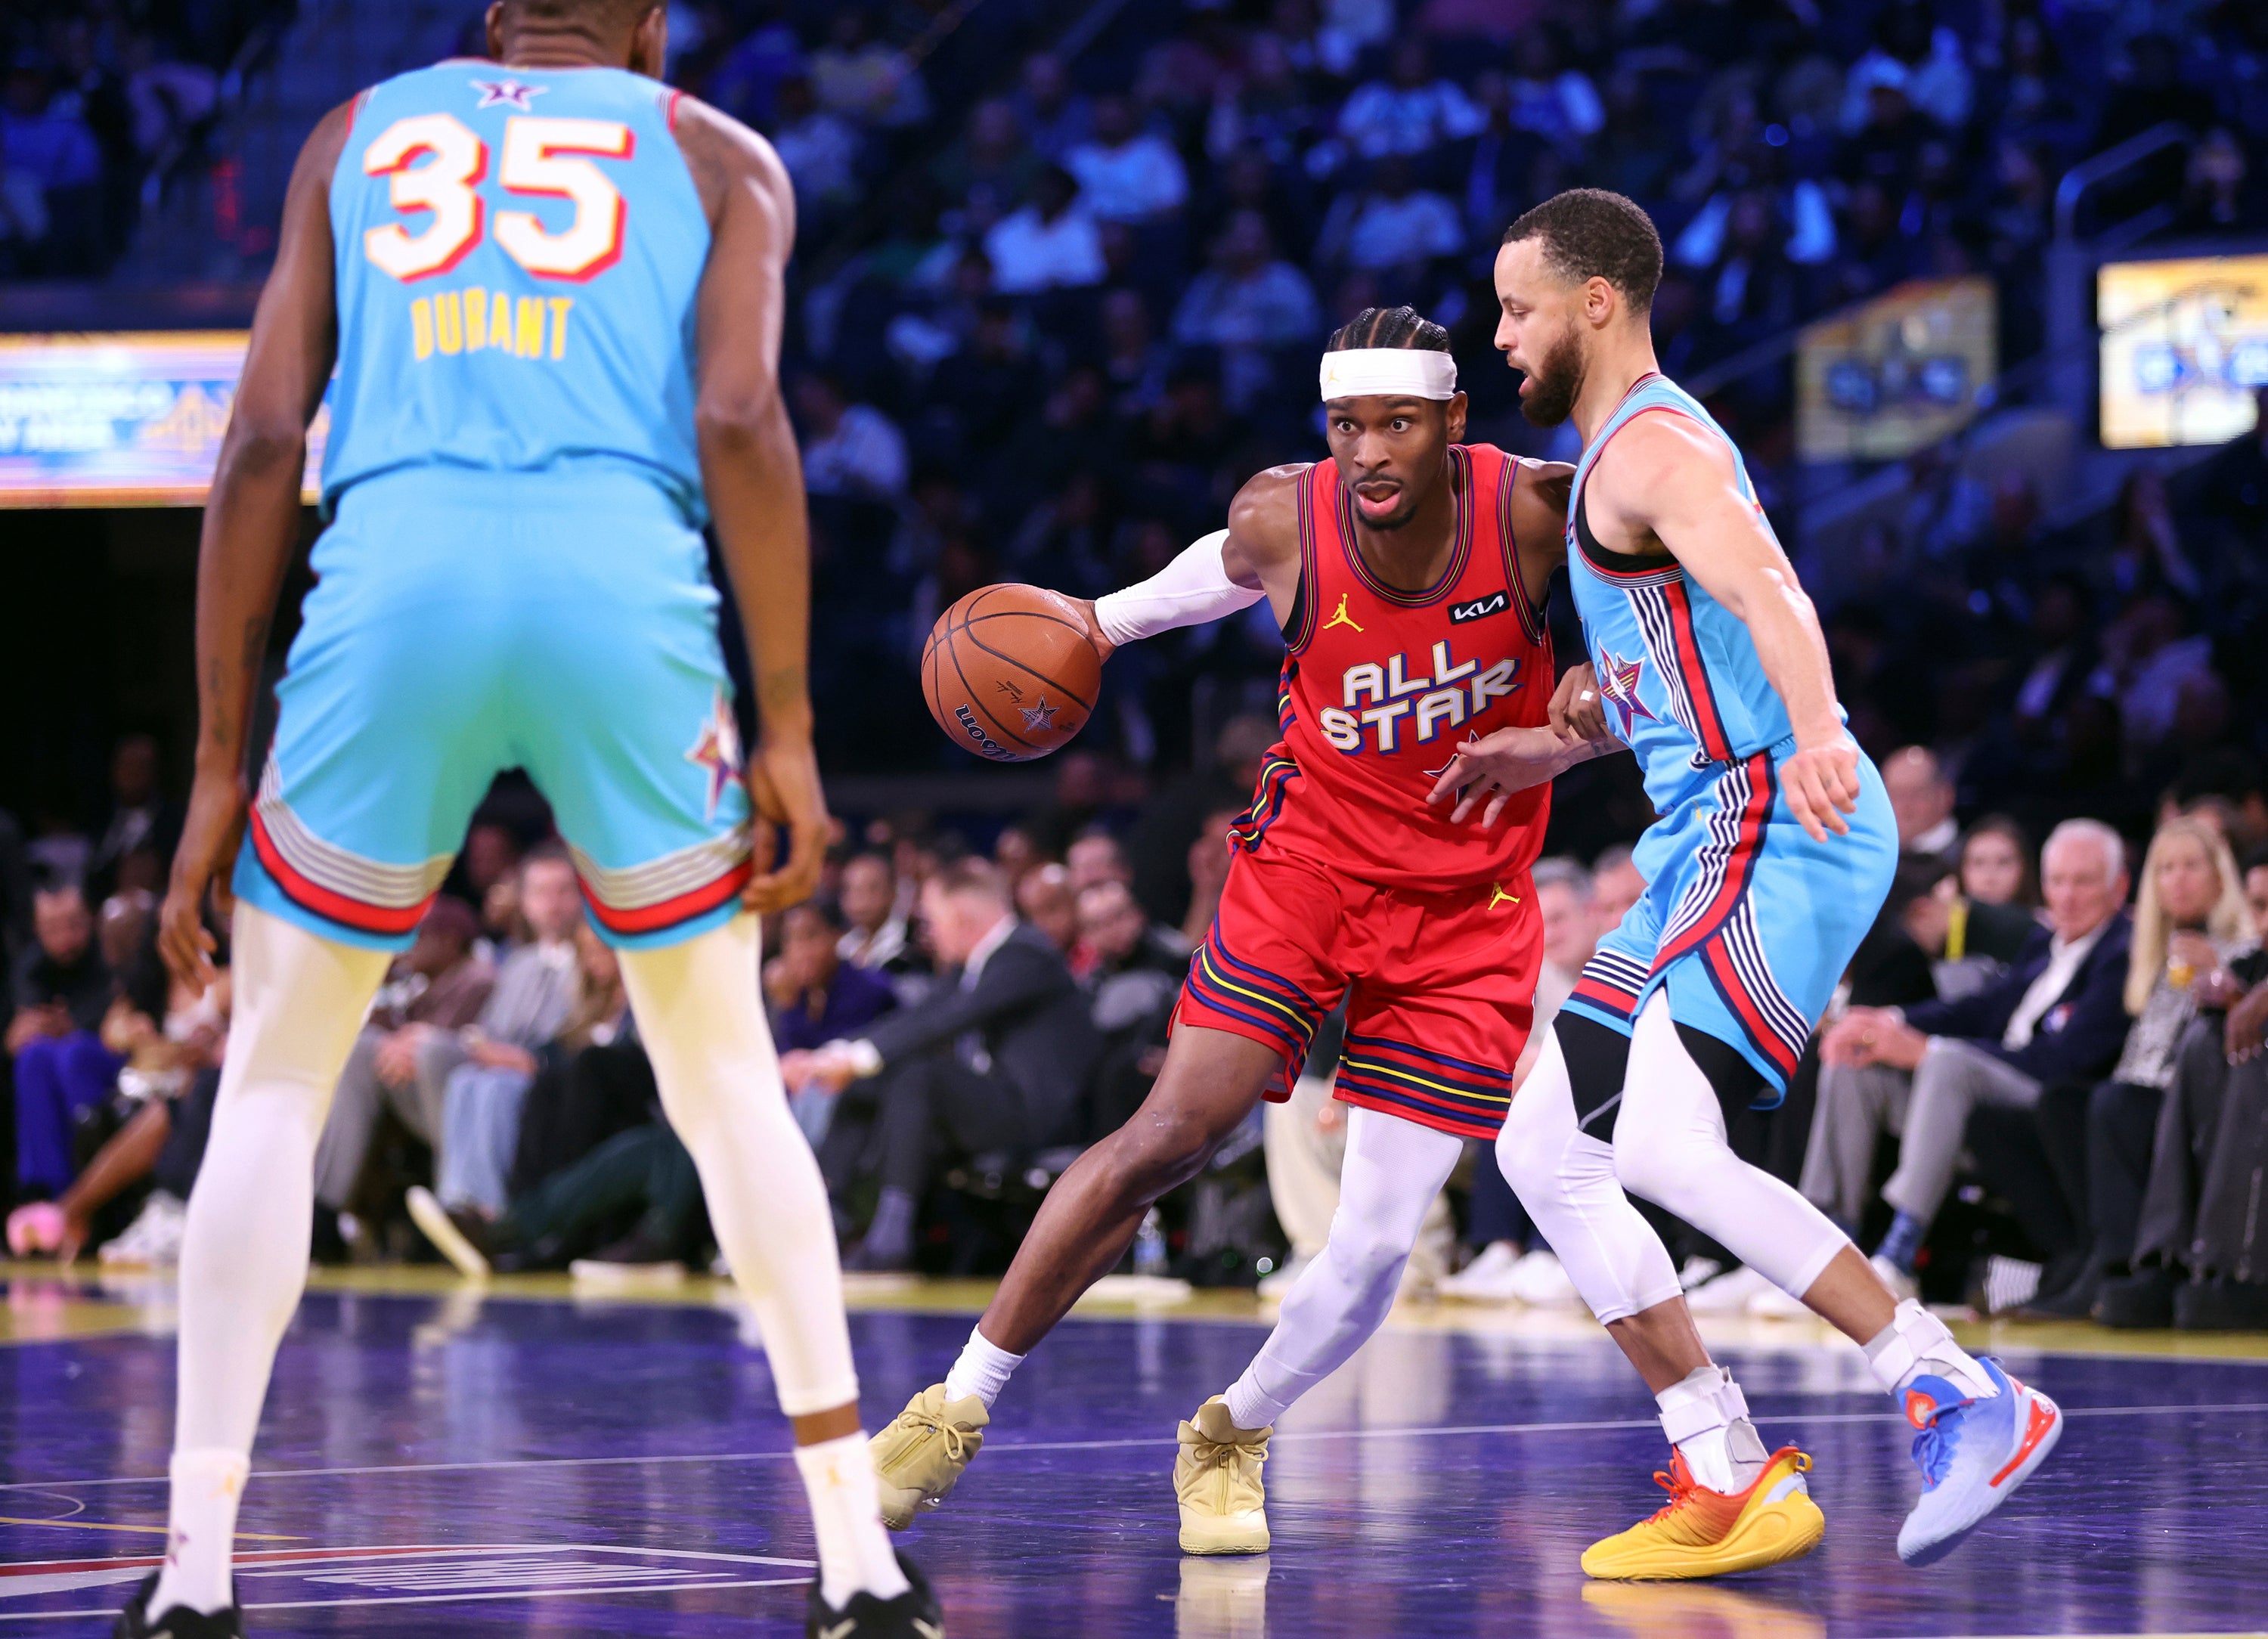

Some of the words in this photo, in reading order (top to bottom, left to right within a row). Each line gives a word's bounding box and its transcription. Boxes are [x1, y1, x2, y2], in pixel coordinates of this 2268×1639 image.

[364, 113, 637, 284] 35
[411, 286, 573, 360] DURANT
[1454, 594, 1504, 620] KIA
[1319, 658, 1524, 755] STAR
[1343, 639, 1480, 710] ALL
